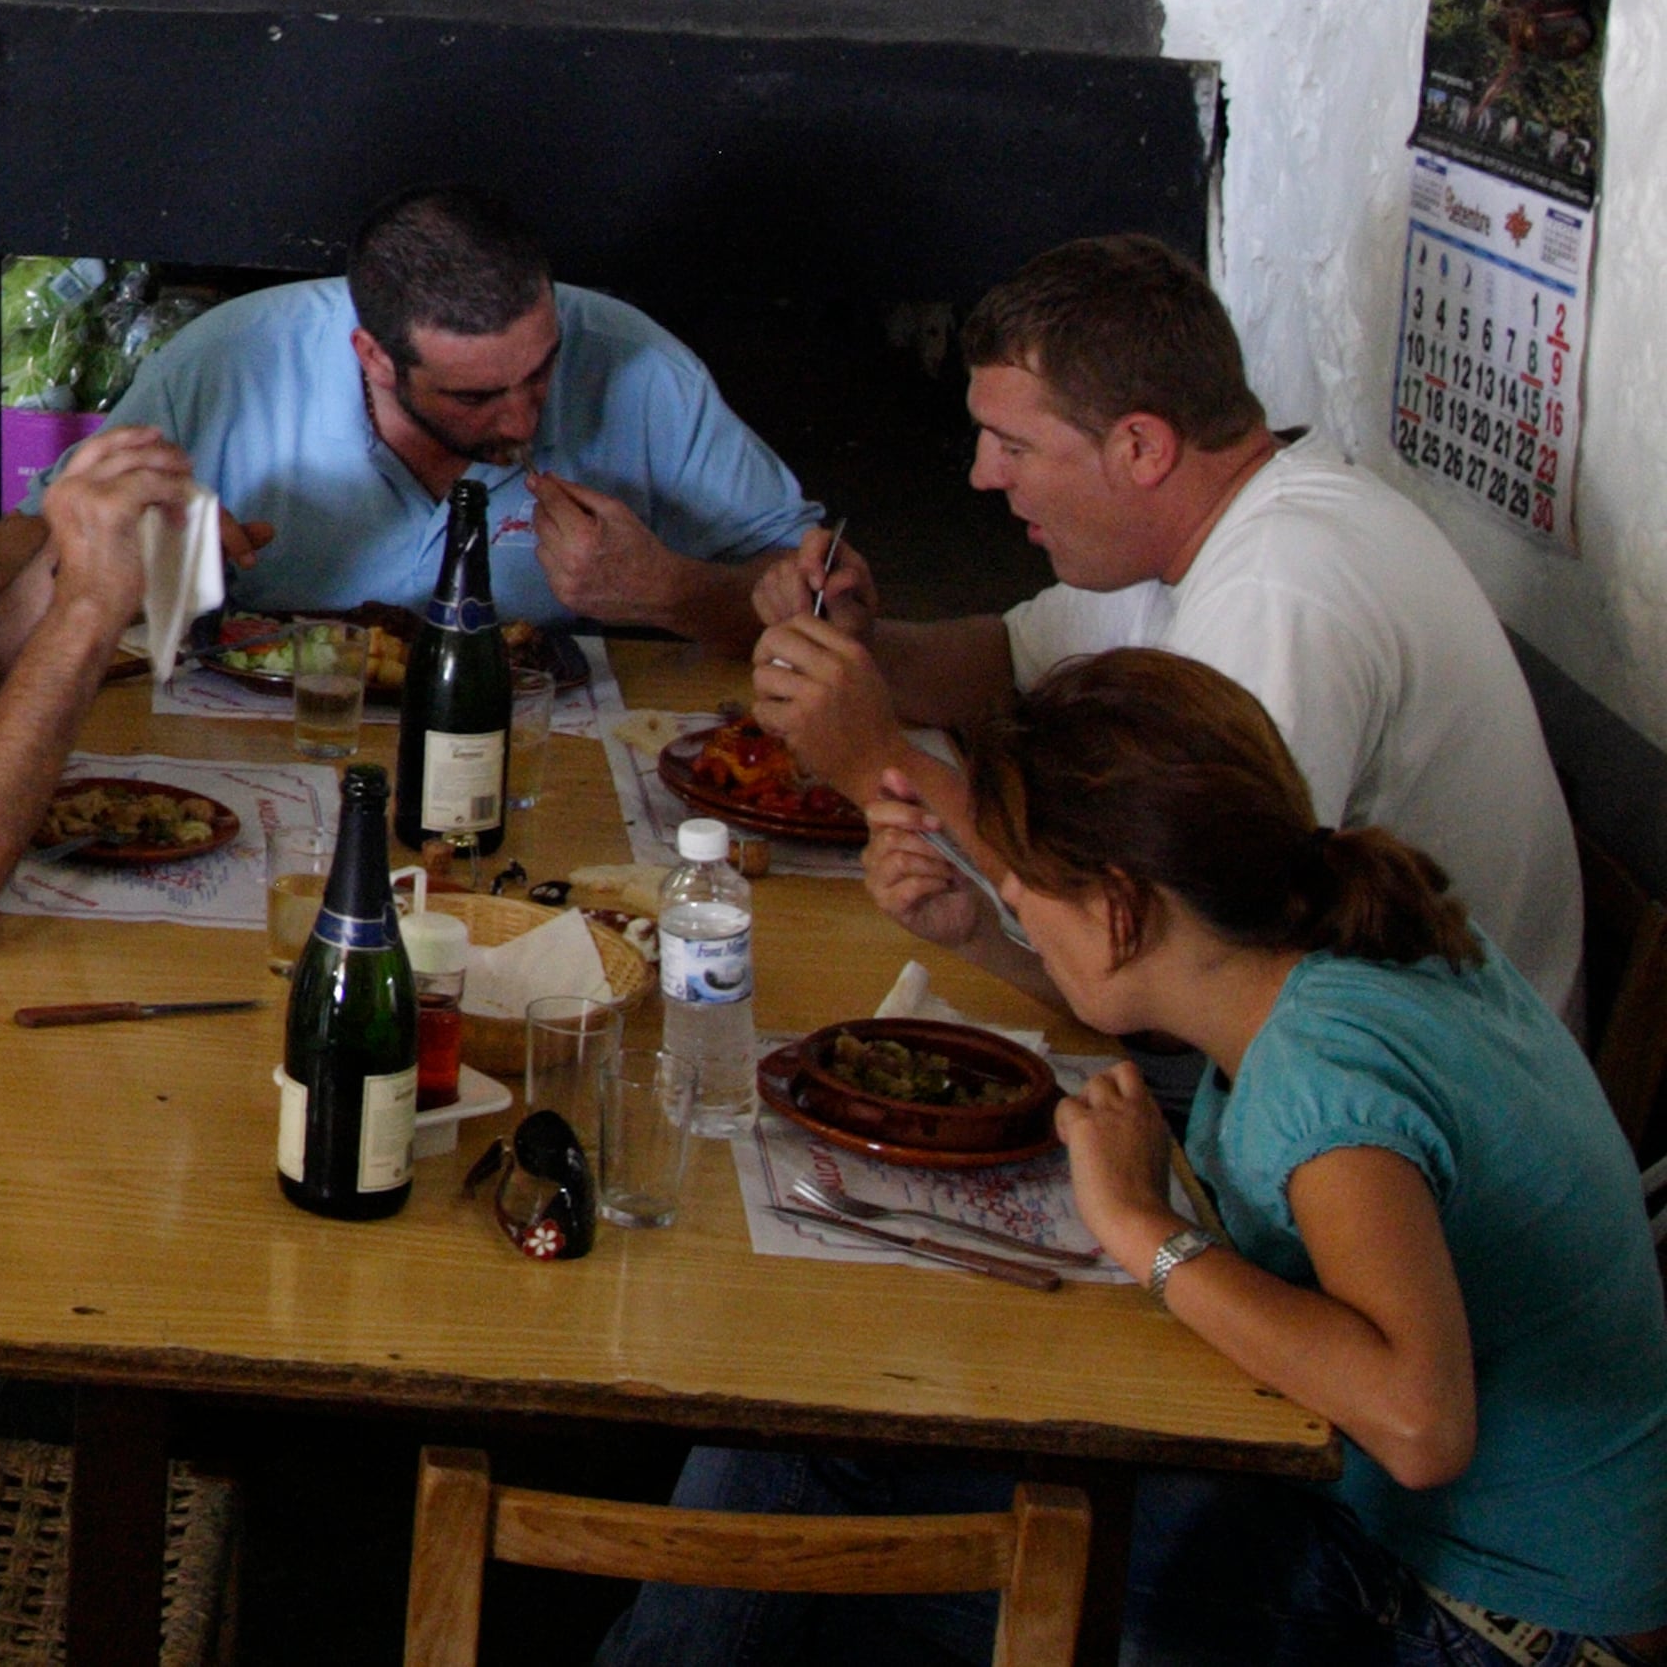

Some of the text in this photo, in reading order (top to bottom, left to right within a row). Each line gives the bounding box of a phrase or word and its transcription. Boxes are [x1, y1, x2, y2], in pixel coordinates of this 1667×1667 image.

[1413, 287, 1563, 386] 3 4 5 6 7 8 9
[1531, 292, 1566, 338] 1 2
[1403, 375, 1558, 485] 17 18 19 20 21 22 23
[1407, 331, 1564, 437] 10 11 12 13 14 15 16
[1399, 419, 1553, 532] 24 25 26 27 28 29 30
